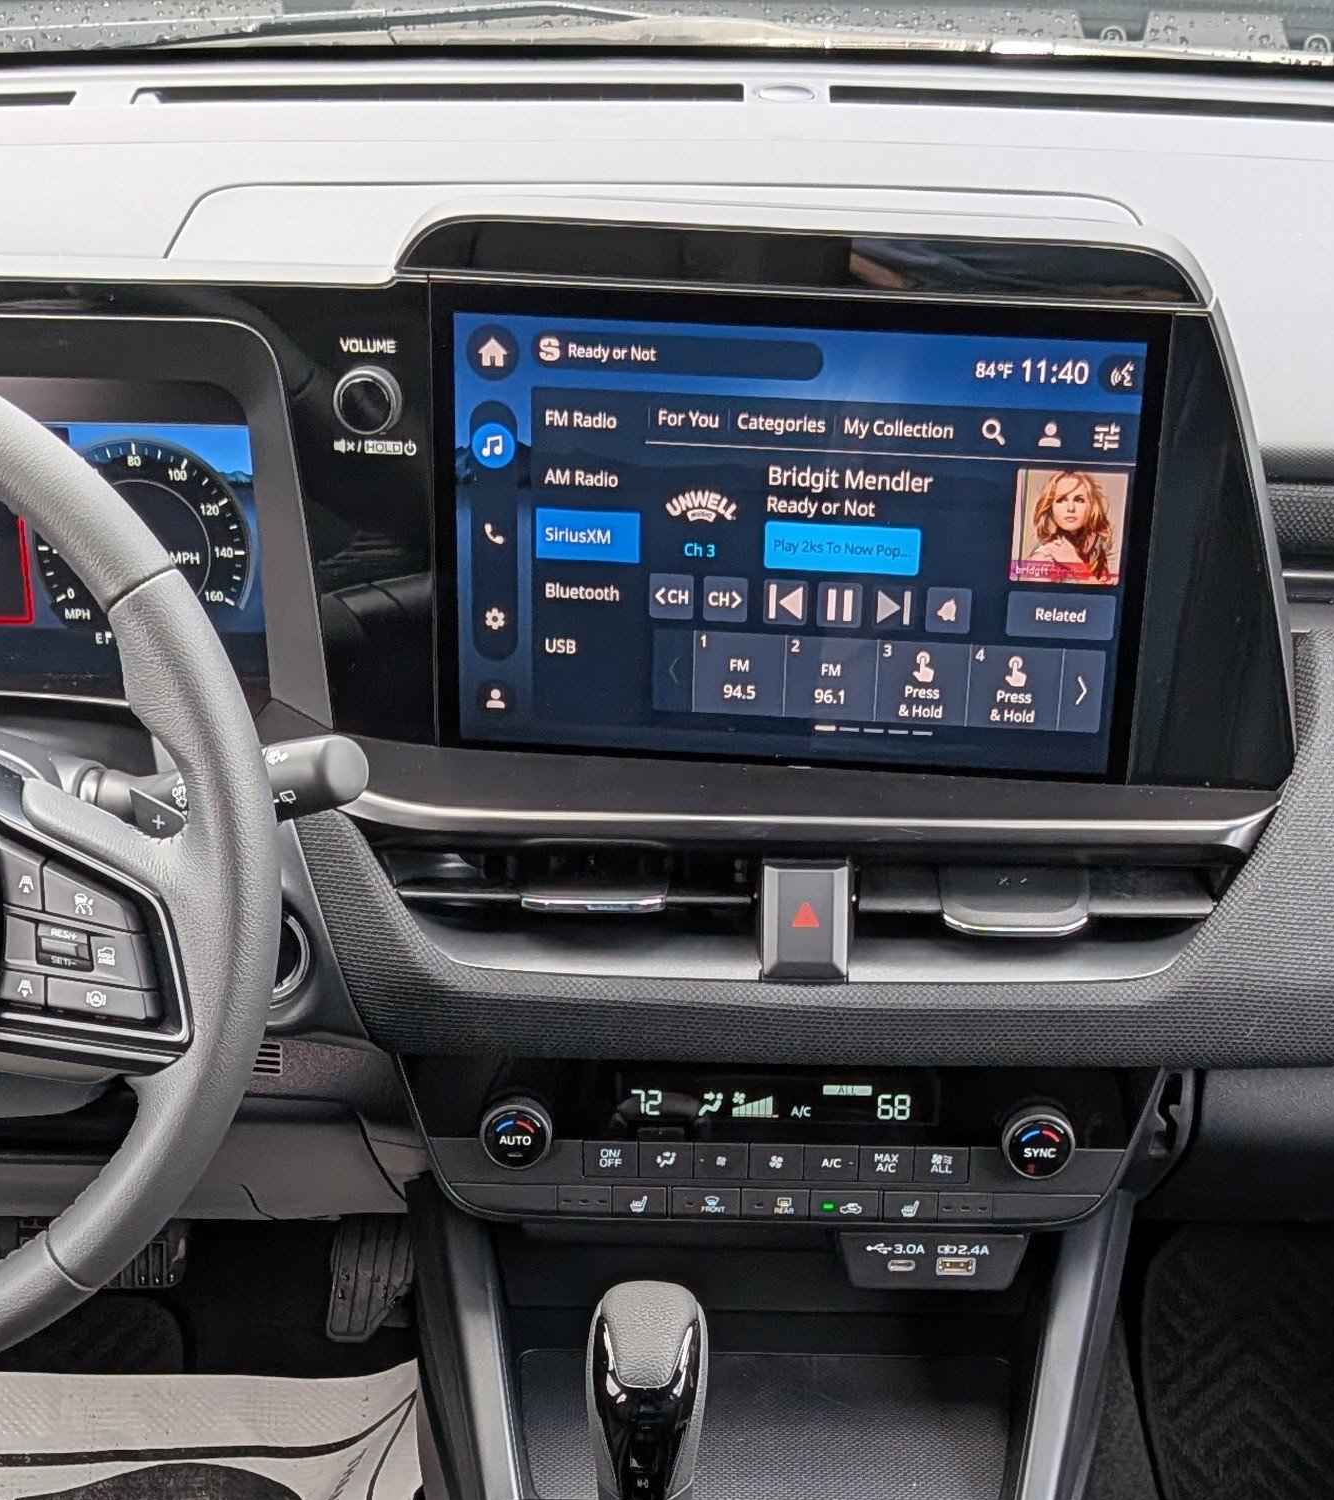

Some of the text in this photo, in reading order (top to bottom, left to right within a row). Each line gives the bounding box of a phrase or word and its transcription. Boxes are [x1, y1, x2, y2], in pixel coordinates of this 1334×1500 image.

[339, 337, 397, 354] VOLUME
[568, 342, 657, 362] Ready or Not
[1021, 357, 1089, 385] 11:40
[545, 409, 617, 429] FM Radio
[658, 408, 720, 429] For You
[737, 413, 826, 436] Categories
[844, 417, 954, 440] My Collection
[366, 442, 401, 454] HOLD
[127, 455, 141, 467] 80
[168, 469, 188, 482] 100
[544, 468, 618, 488] AM Radio
[768, 464, 934, 494] Bridgit Mendler
[200, 503, 220, 516] 120
[665, 489, 737, 521] UNWELL
[767, 496, 876, 519] Ready or Not
[545, 527, 611, 545] SiriusXM
[214, 546, 234, 558] 140
[684, 542, 715, 557] Ch 3
[774, 539, 799, 555] Play
[826, 542, 840, 555] To
[845, 543, 873, 556] Now
[205, 590, 224, 602] 160
[545, 582, 620, 602] Bluetooth
[64, 608, 91, 621] MPH
[1035, 607, 1087, 623] Related
[545, 637, 576, 655] USB
[729, 658, 749, 673] FM
[821, 663, 841, 677] FM
[723, 684, 756, 700] 94.5
[814, 688, 845, 705] 96.1
[904, 685, 940, 700] Press
[996, 690, 1032, 705] Press
[898, 703, 943, 720] & Hold
[990, 708, 1035, 724] & Hold
[630, 1089, 663, 1116] 72
[877, 1094, 911, 1121] 68
[790, 1106, 812, 1118] A/C
[499, 1135, 532, 1147] AUTO
[600, 1148, 621, 1159] ON/
[874, 1153, 899, 1163] MAX
[1023, 1147, 1057, 1159] SYNC
[599, 1158, 622, 1168] OFF
[821, 1158, 842, 1169] A/C
[875, 1162, 897, 1174] A/C
[930, 1164, 953, 1174] ALL
[893, 1243, 925, 1255] 3.0A
[957, 1244, 990, 1256] 2.4A
